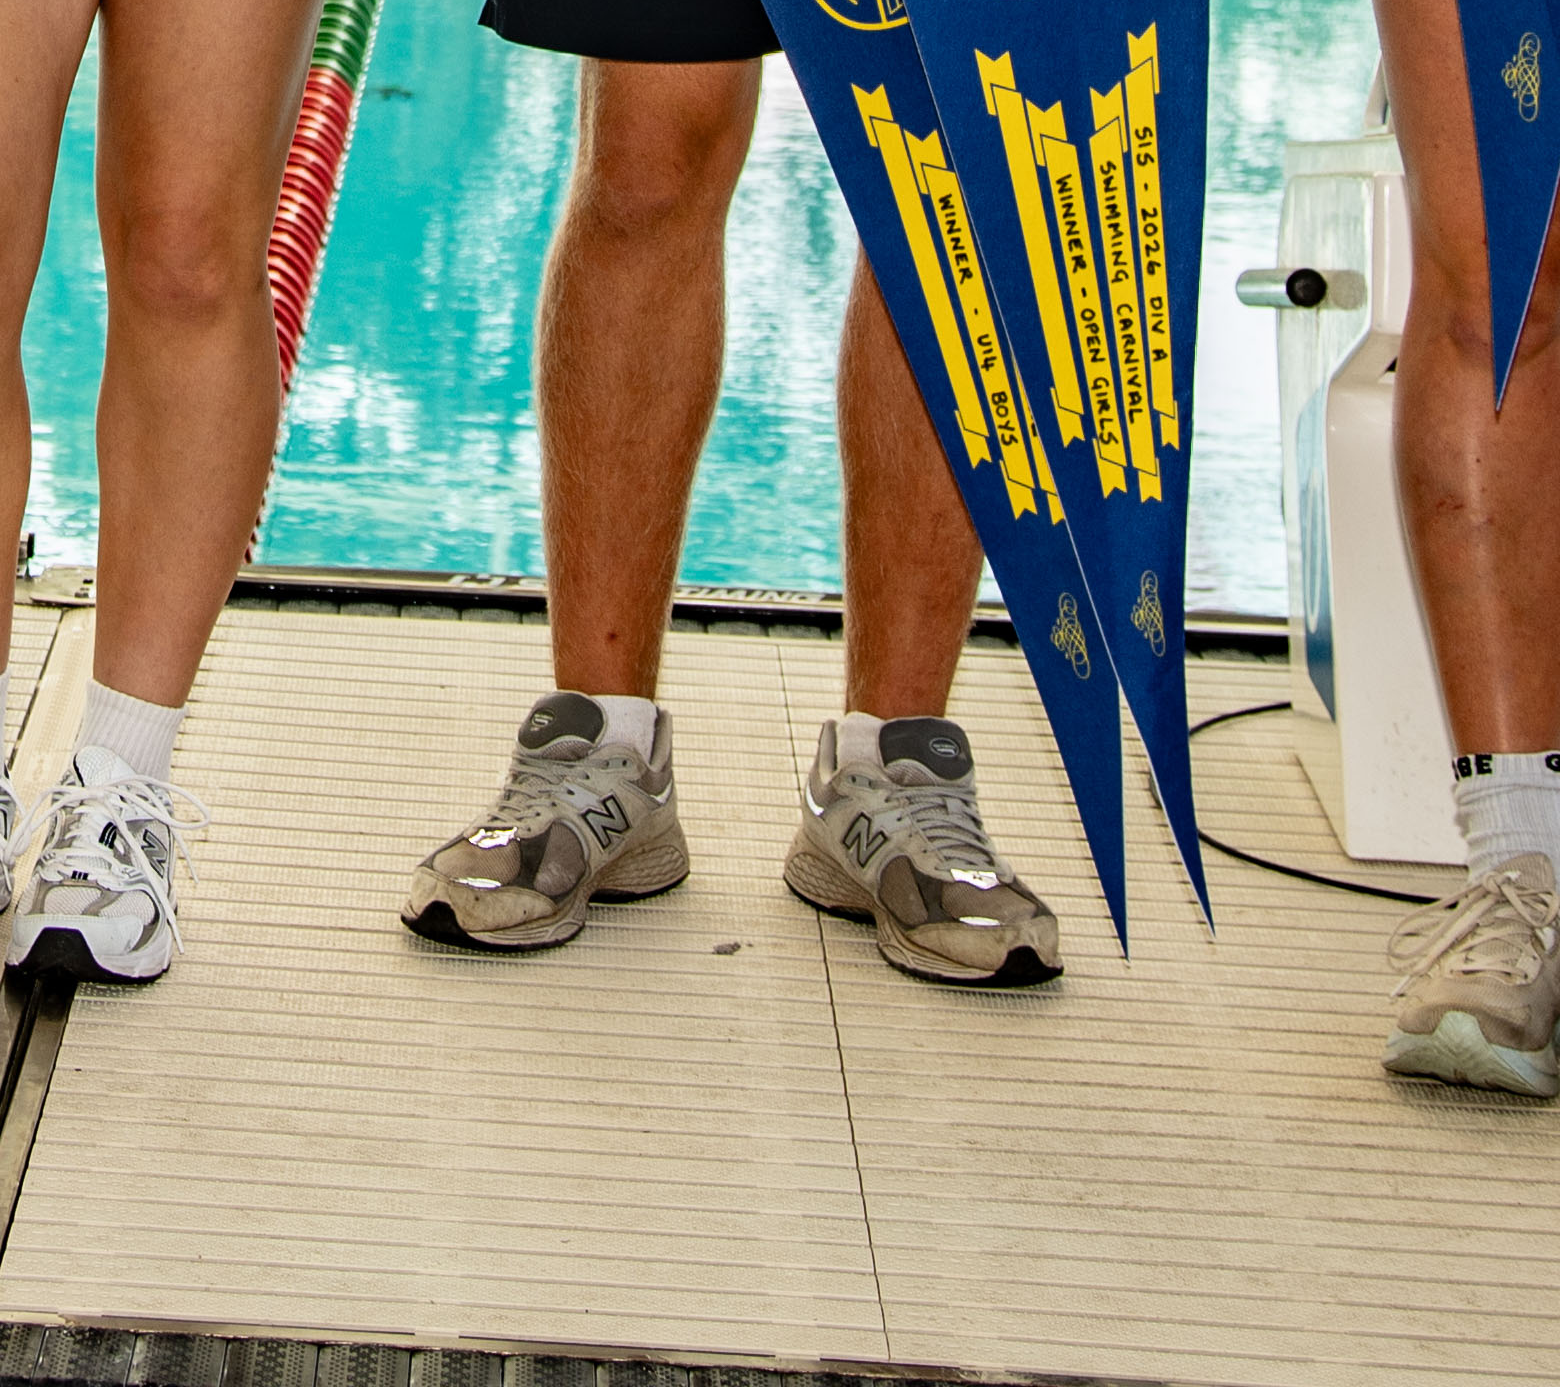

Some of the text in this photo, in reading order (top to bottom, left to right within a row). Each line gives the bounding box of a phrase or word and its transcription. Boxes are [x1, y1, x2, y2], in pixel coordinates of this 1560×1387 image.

[938, 193, 1019, 447] WINNER U14 BOYS
[1055, 173, 1119, 447] WINNER OPEN GIRLS
[1099, 160, 1144, 425] SWIMMING CARNIVAL
[1134, 126, 1169, 362] SIS 2026 DIV A
[677, 586, 826, 605] TIMING
